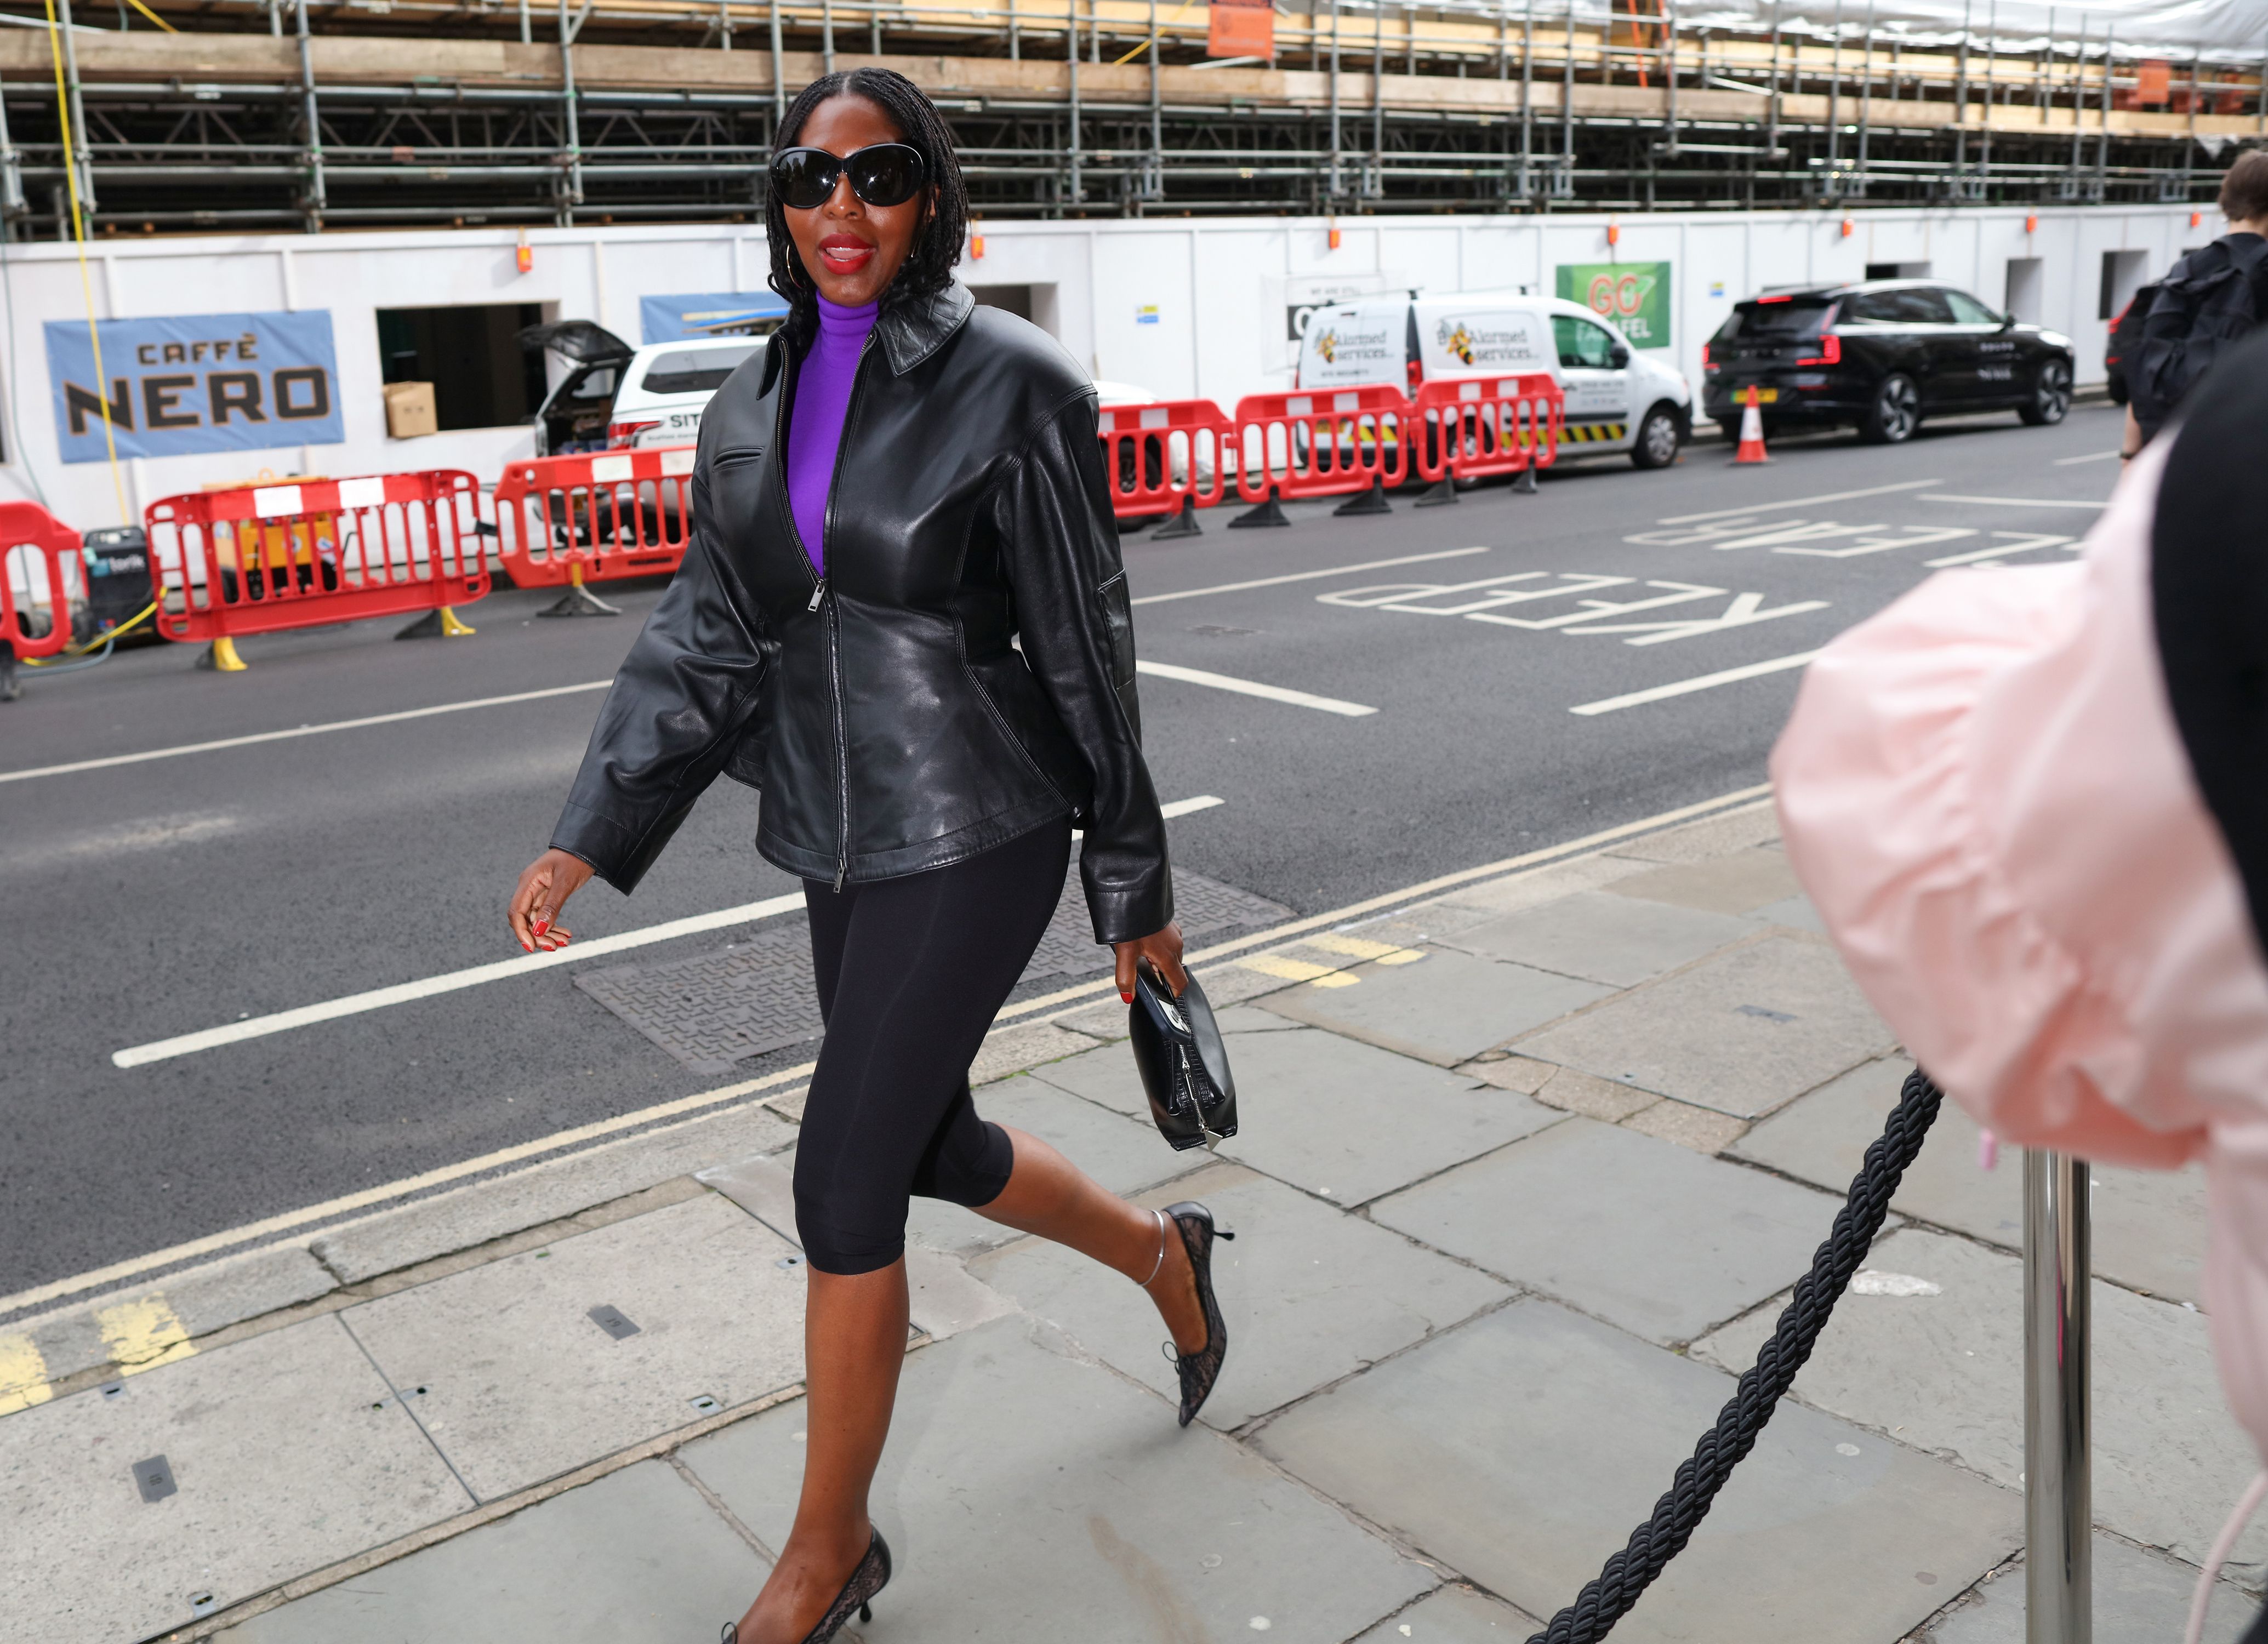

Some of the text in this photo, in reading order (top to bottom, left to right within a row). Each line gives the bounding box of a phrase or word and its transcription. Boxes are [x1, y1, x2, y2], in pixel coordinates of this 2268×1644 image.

[1588, 272, 1644, 318] GO
[62, 366, 330, 436] NERO
[670, 414, 700, 427] SIT
[1621, 517, 2083, 568] LEAR
[1315, 571, 1832, 646] KEEP
